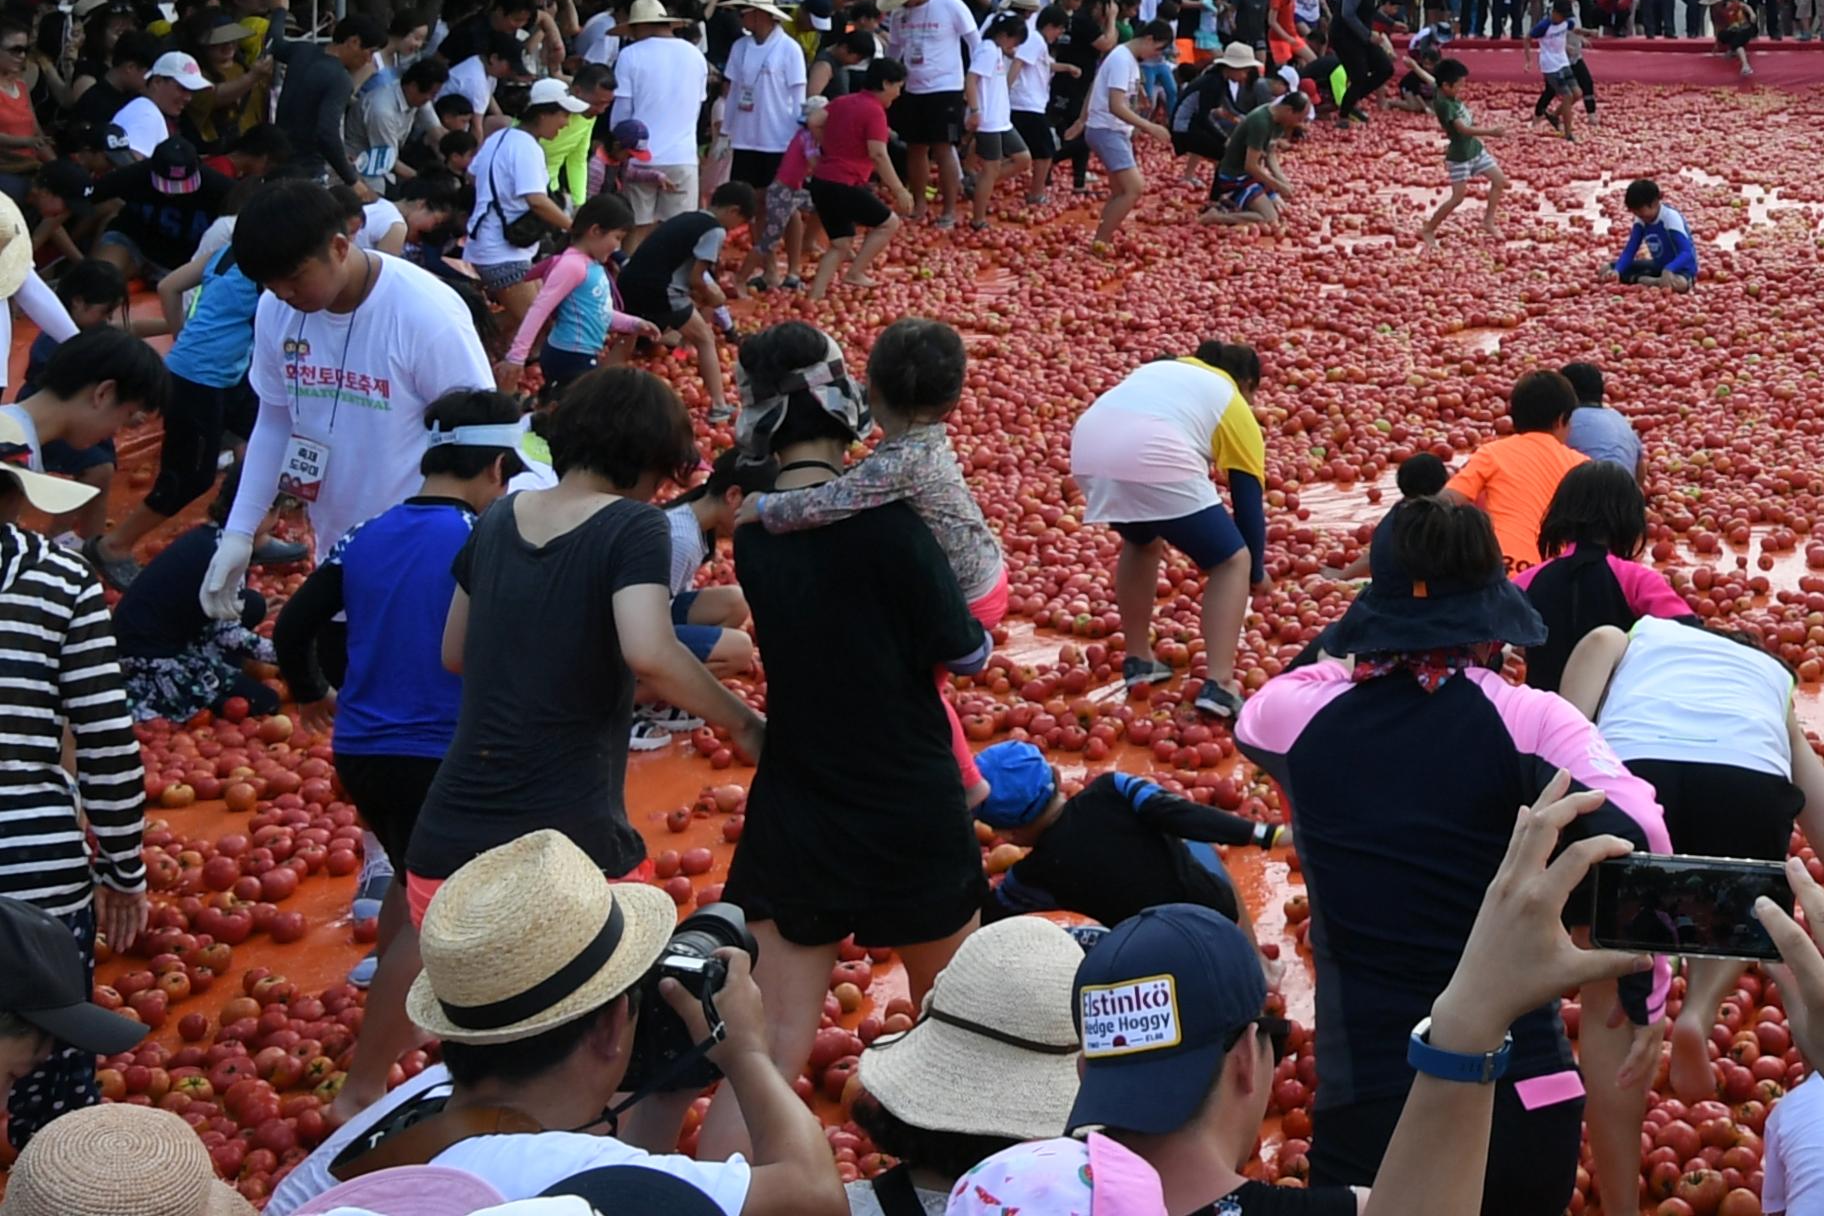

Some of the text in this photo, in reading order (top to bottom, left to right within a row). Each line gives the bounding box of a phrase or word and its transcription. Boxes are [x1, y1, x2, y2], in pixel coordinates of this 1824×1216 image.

[285, 363, 391, 400] 화천토마토축제
[298, 446, 319, 464] 축제
[289, 458, 320, 478] 도우미
[1083, 982, 1170, 1018] Elstinkö
[1118, 1012, 1171, 1034] Hoggy
